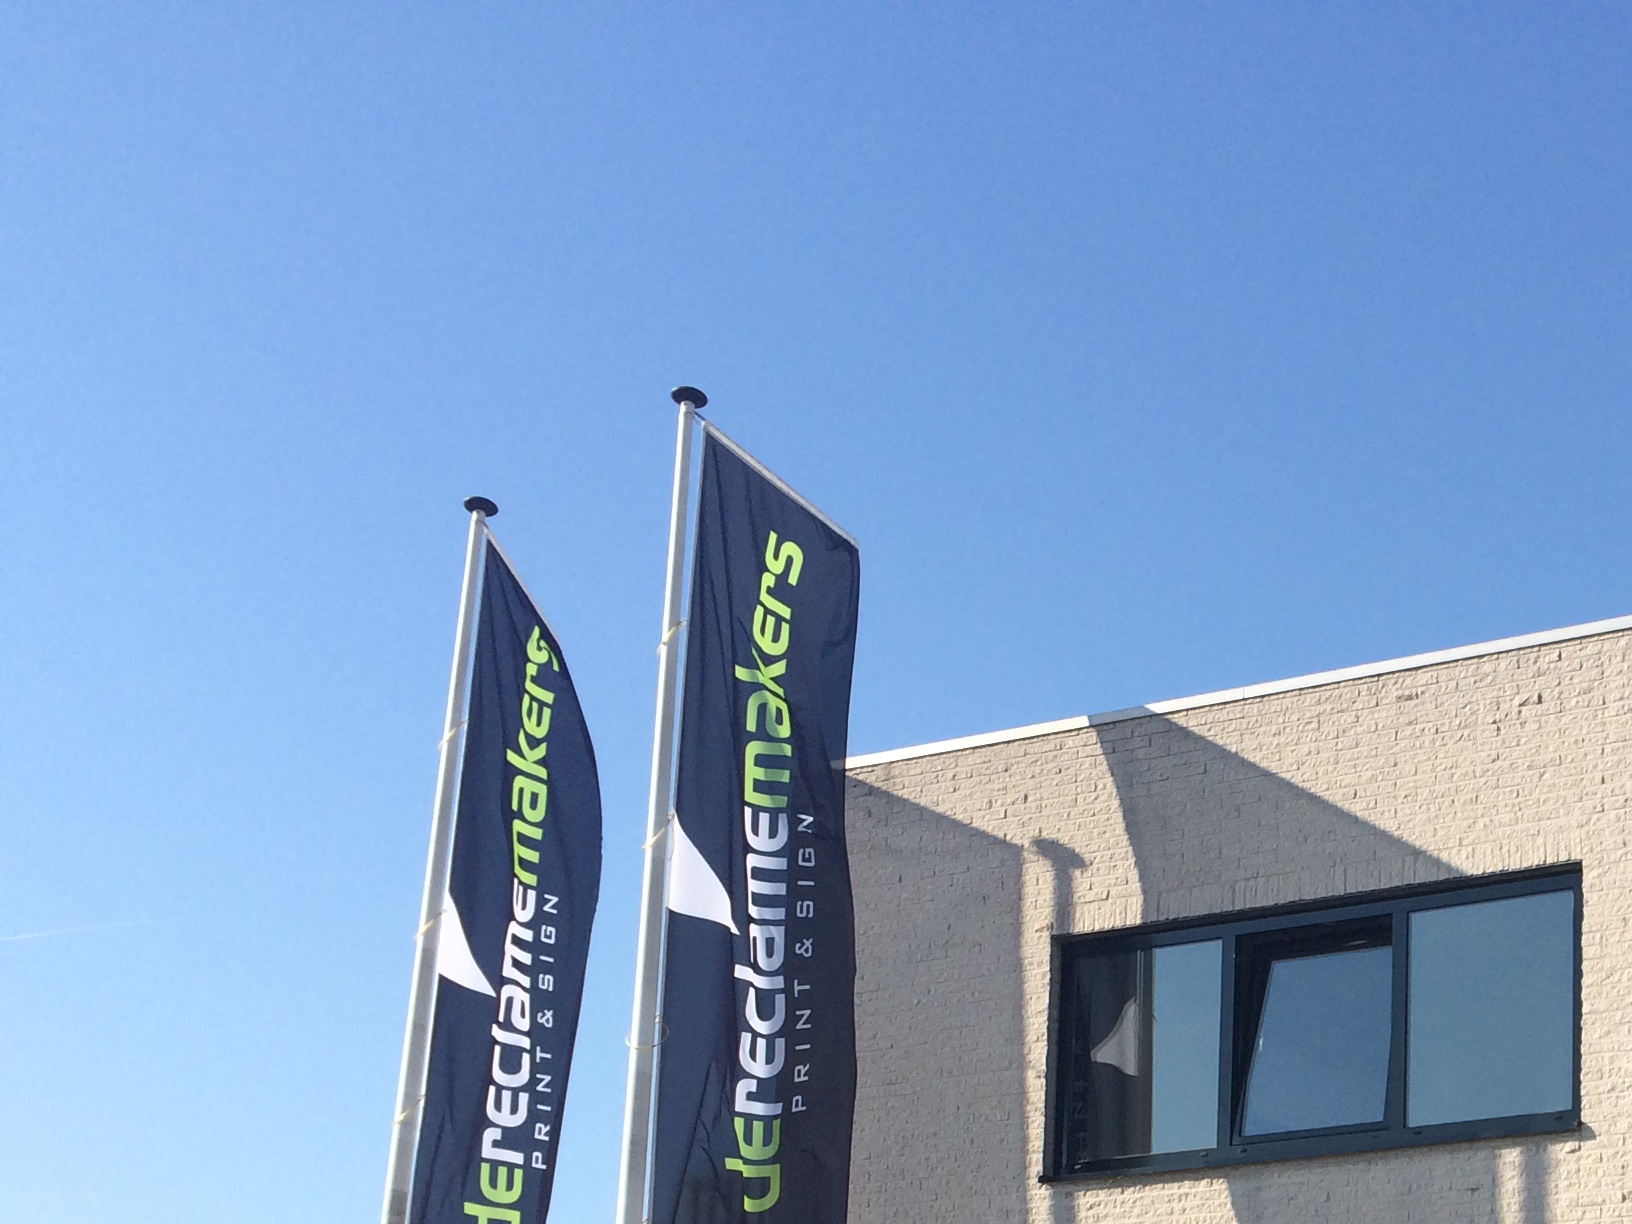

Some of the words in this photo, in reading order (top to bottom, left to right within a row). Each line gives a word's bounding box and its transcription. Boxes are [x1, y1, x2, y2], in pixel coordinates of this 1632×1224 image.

[724, 530, 804, 1214] dereclamemakers
[797, 813, 816, 918] SIGN
[538, 894, 560, 992] SIGN
[794, 936, 814, 958] &
[536, 1009, 554, 1028] &
[791, 979, 812, 1113] PRINT
[531, 1046, 553, 1169] PRINT
